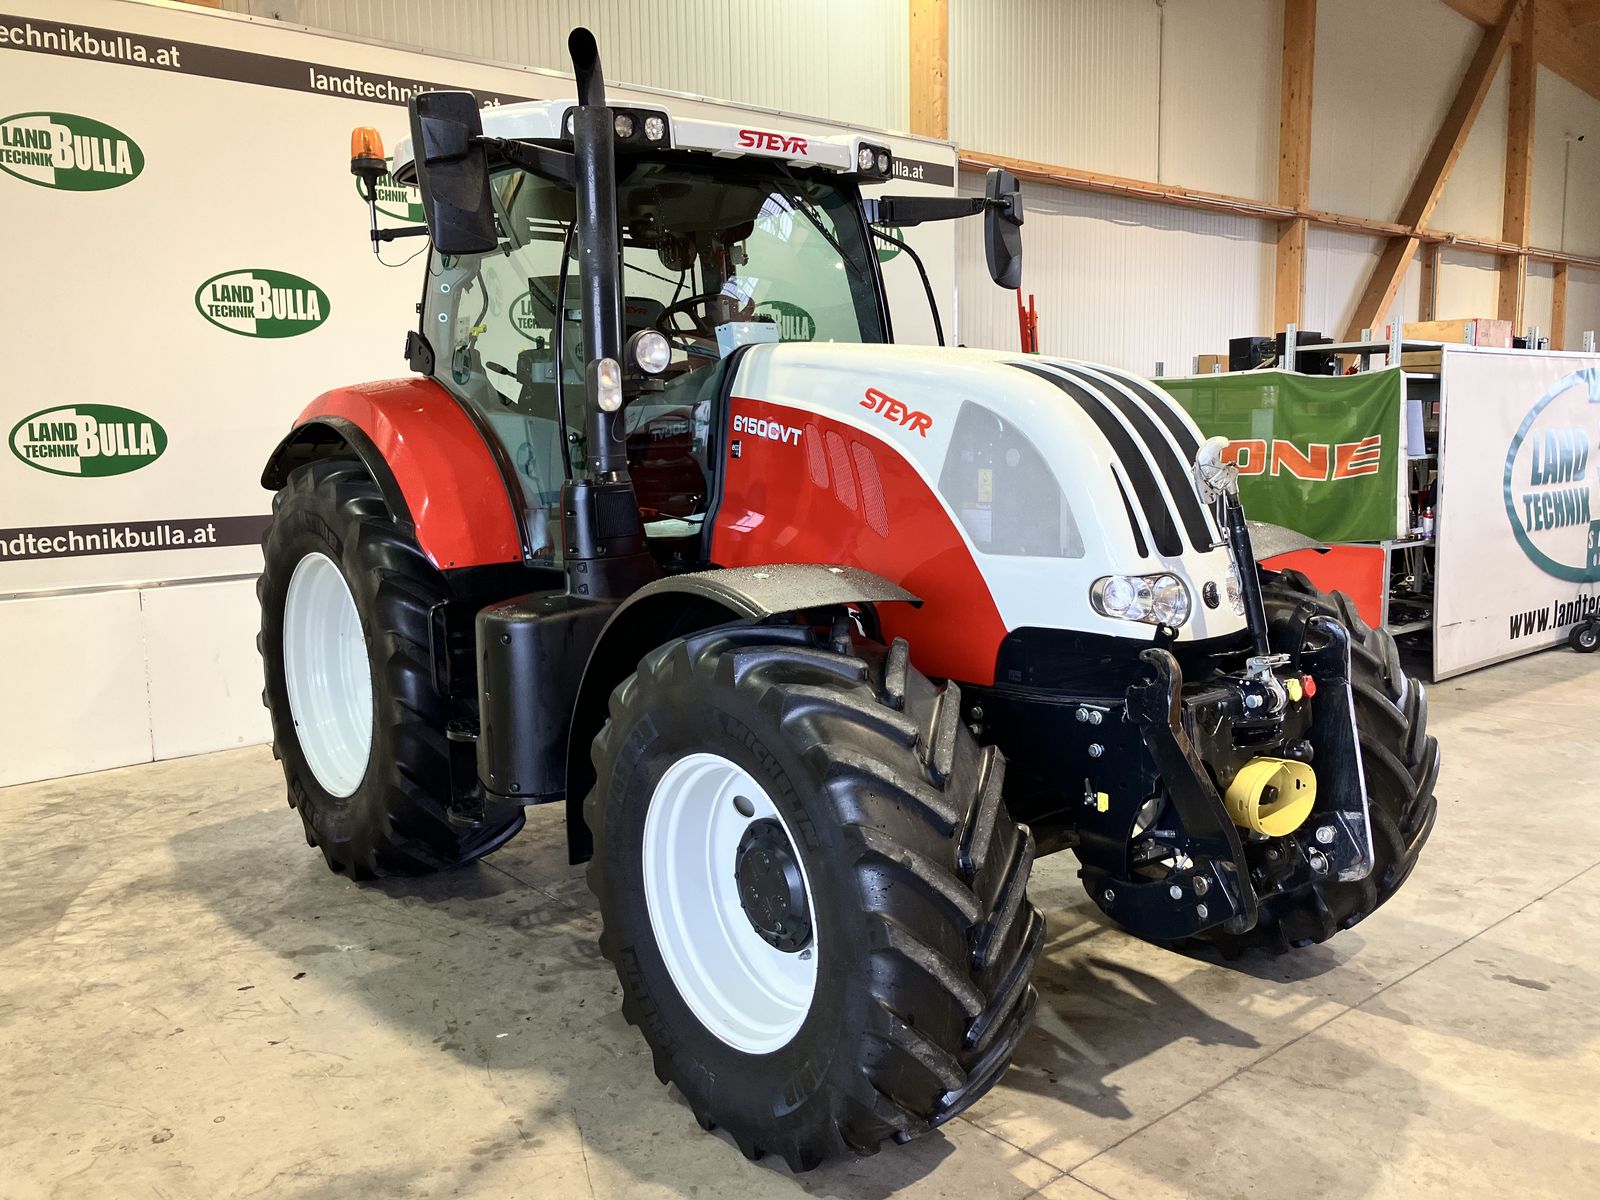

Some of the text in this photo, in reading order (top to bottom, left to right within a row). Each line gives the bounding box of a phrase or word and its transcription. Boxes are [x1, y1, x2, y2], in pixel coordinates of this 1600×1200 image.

[2, 125, 52, 150] LAND
[51, 123, 134, 175] BULLA
[737, 129, 808, 155] STEYR
[211, 284, 254, 303] LAND
[252, 279, 321, 320] BULLA
[207, 304, 255, 318] TECHNIK
[859, 387, 933, 438] STEYR
[28, 422, 78, 442] LAND
[76, 415, 157, 457] BULLA
[733, 414, 802, 446] 6150CVT
[23, 444, 80, 458] TECHNIK
[1530, 428, 1590, 486] LAND
[1522, 487, 1591, 532] TECHNIK
